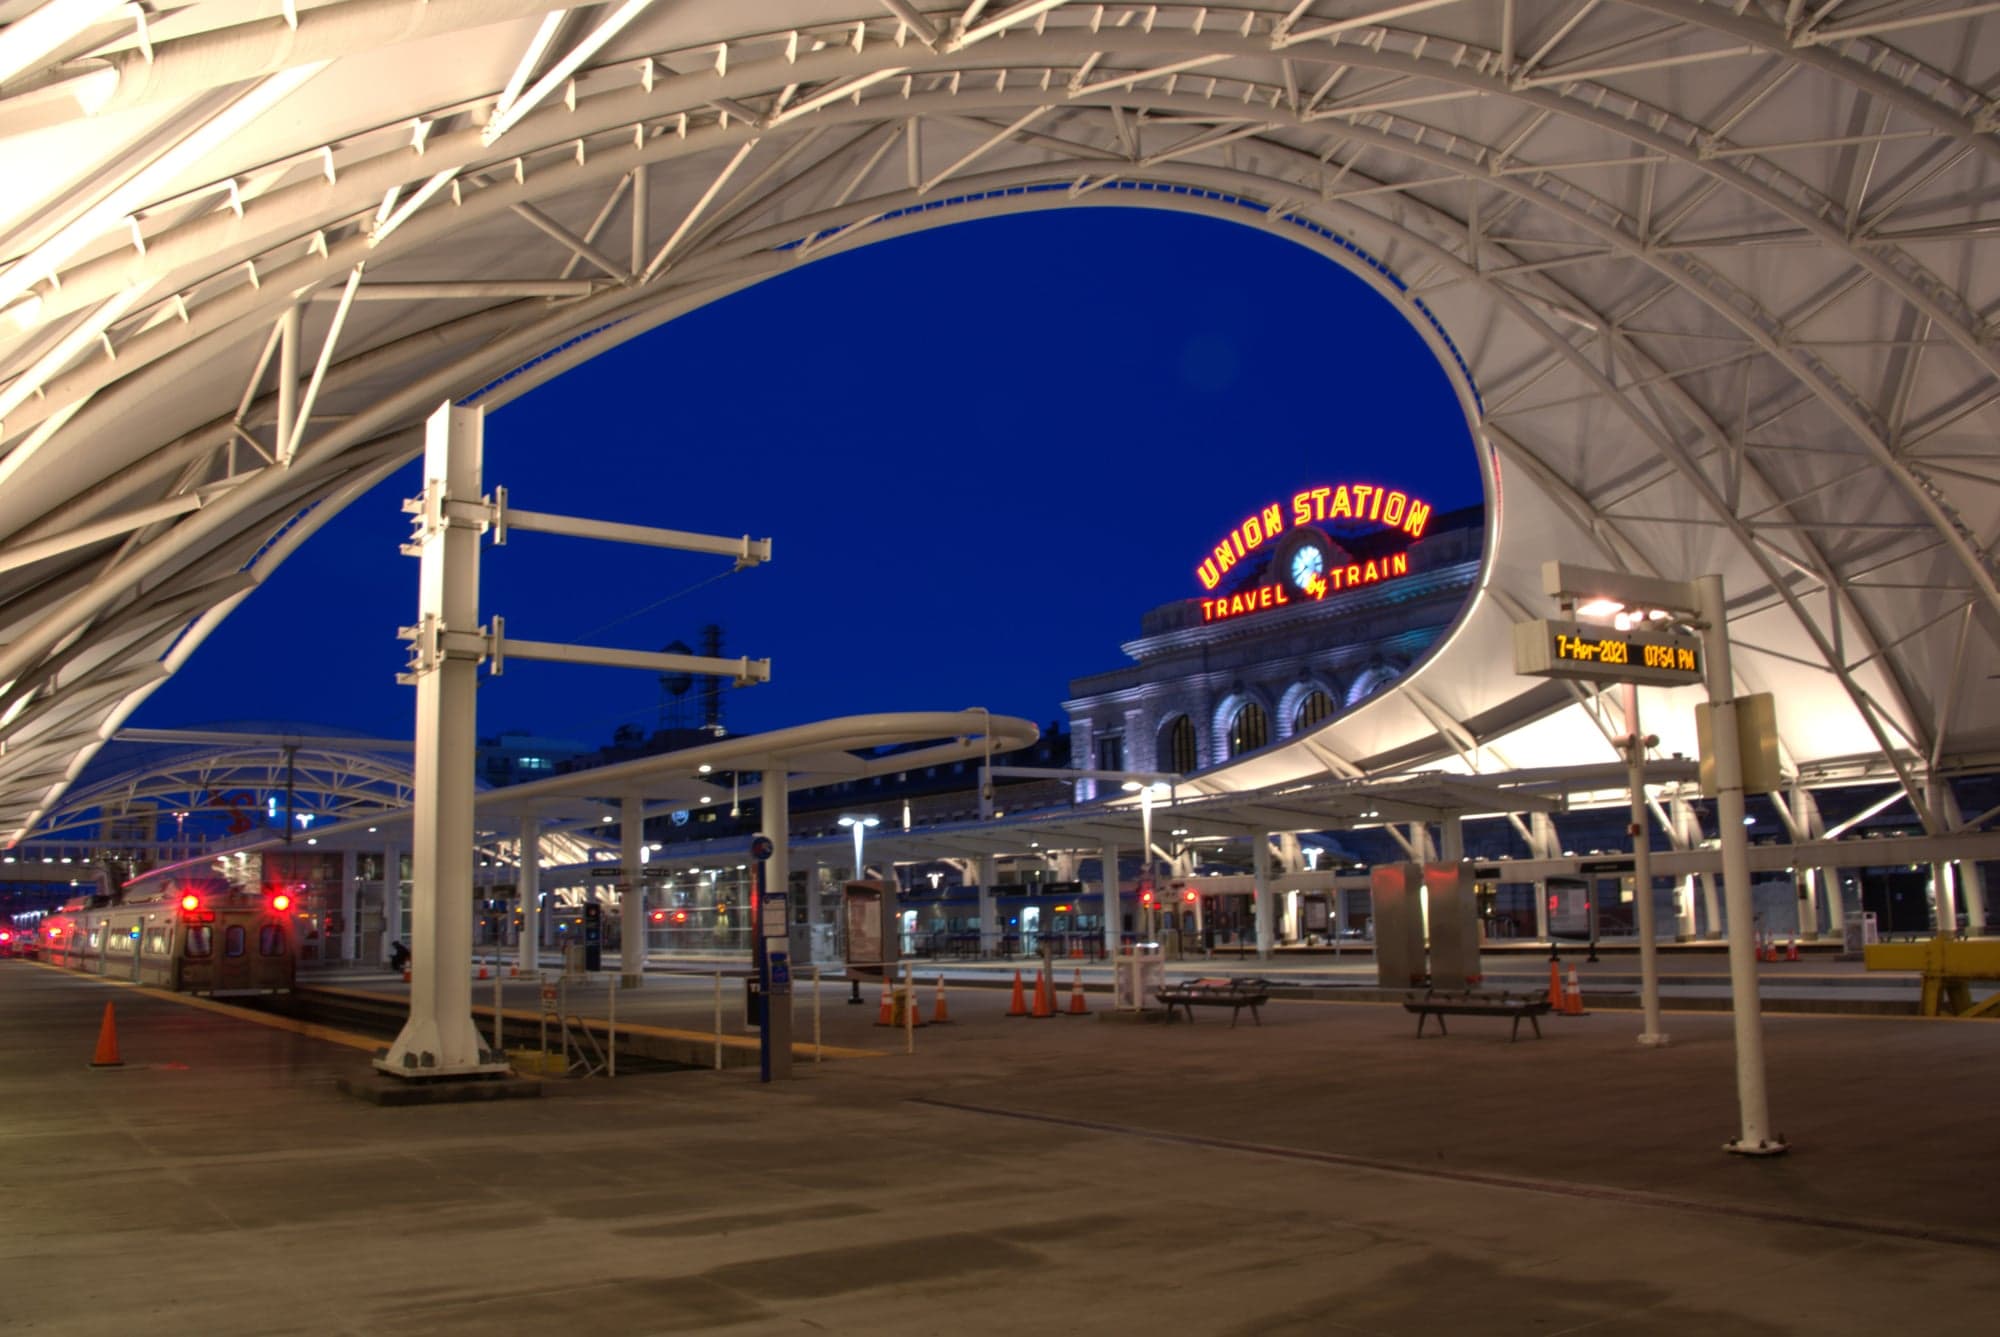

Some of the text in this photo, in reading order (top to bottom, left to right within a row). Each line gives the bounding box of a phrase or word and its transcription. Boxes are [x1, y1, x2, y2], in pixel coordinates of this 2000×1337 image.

[1197, 484, 1431, 590] UNION STATION
[1202, 554, 1408, 620] TRAVEL by TRAIN
[1557, 634, 1695, 671] 7-Apr-2021 07:54 PM
